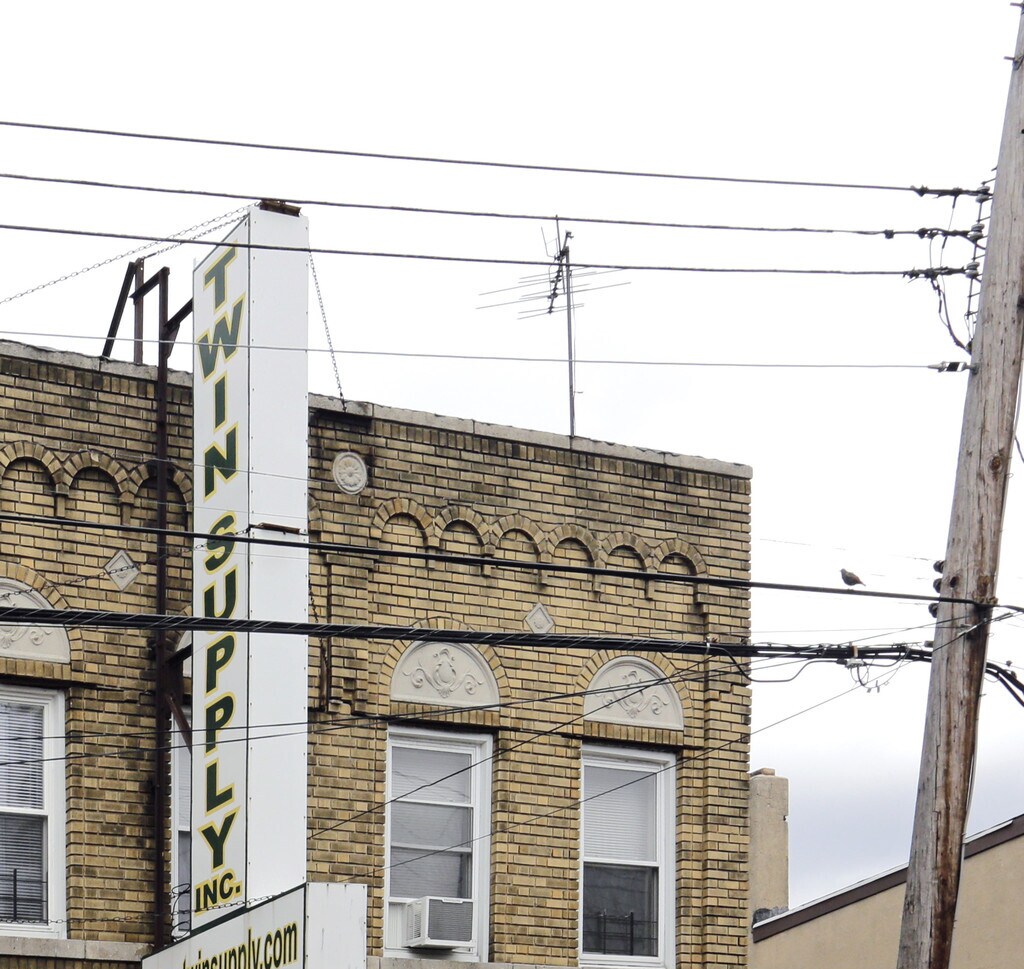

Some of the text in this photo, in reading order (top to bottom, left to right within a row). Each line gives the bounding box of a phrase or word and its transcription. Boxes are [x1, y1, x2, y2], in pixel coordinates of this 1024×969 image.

[194, 240, 246, 915] TWIN SUPPLY INC.
